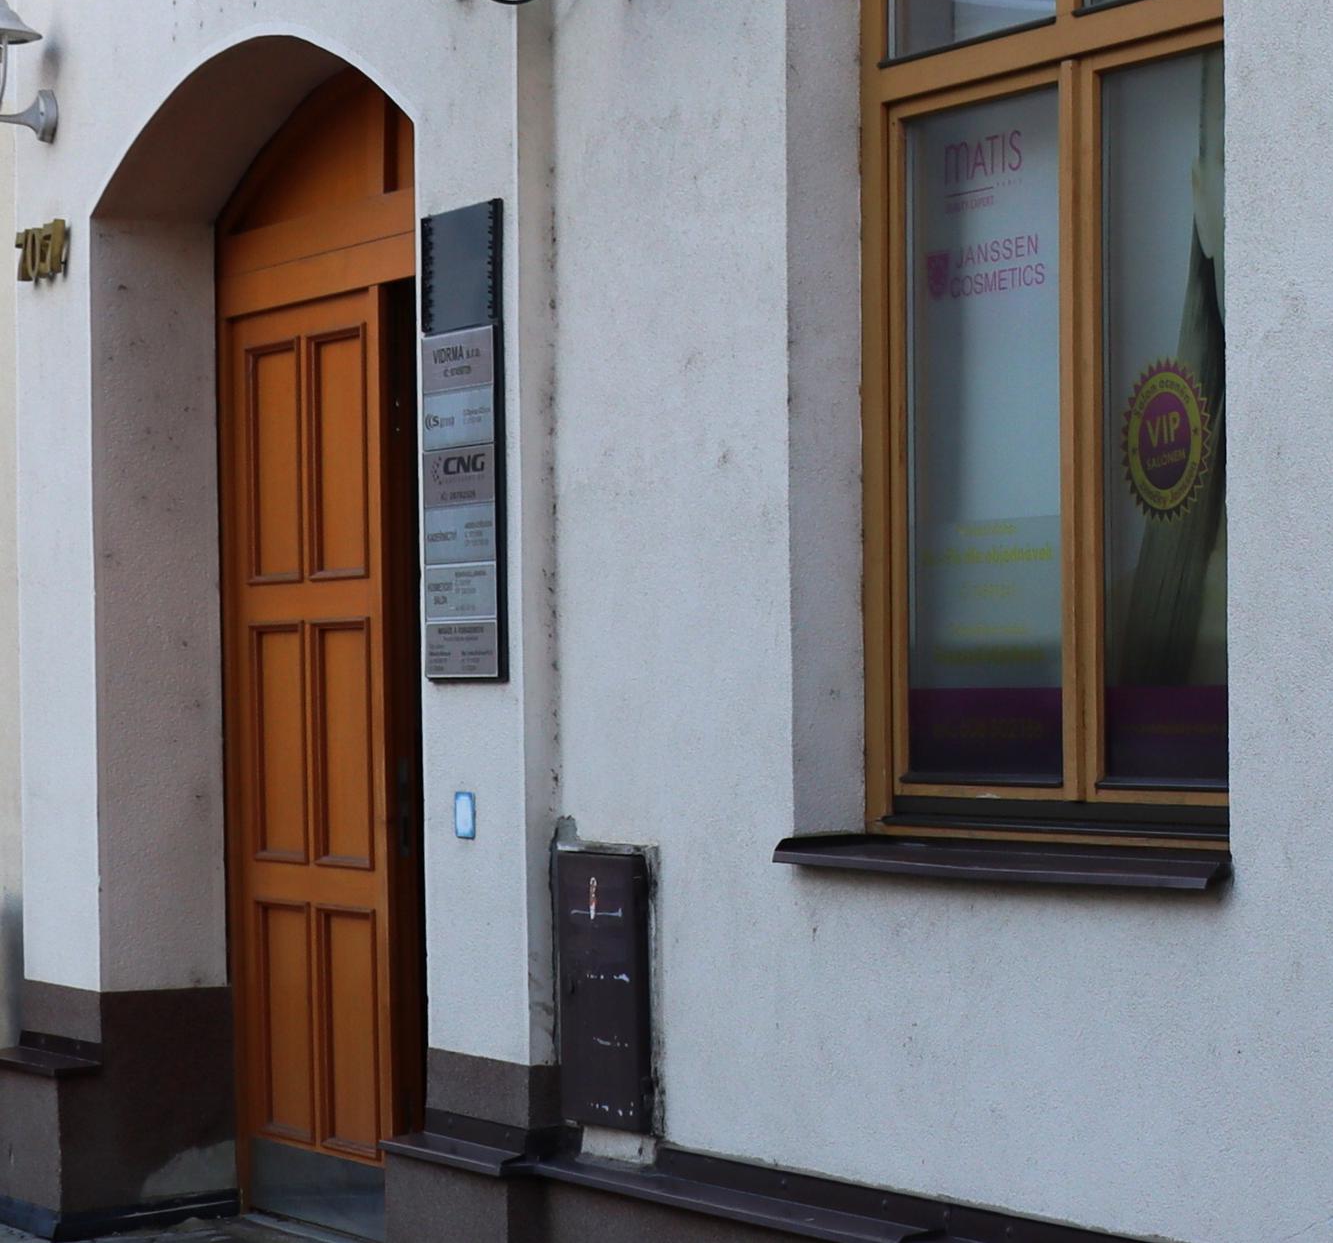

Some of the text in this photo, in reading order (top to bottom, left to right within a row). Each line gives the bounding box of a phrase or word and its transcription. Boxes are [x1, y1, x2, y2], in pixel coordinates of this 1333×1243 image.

[955, 234, 1039, 270] JANSSEN
[951, 263, 1046, 298] COSMETICS
[1146, 411, 1180, 449] VIP
[443, 453, 486, 476] CNG
